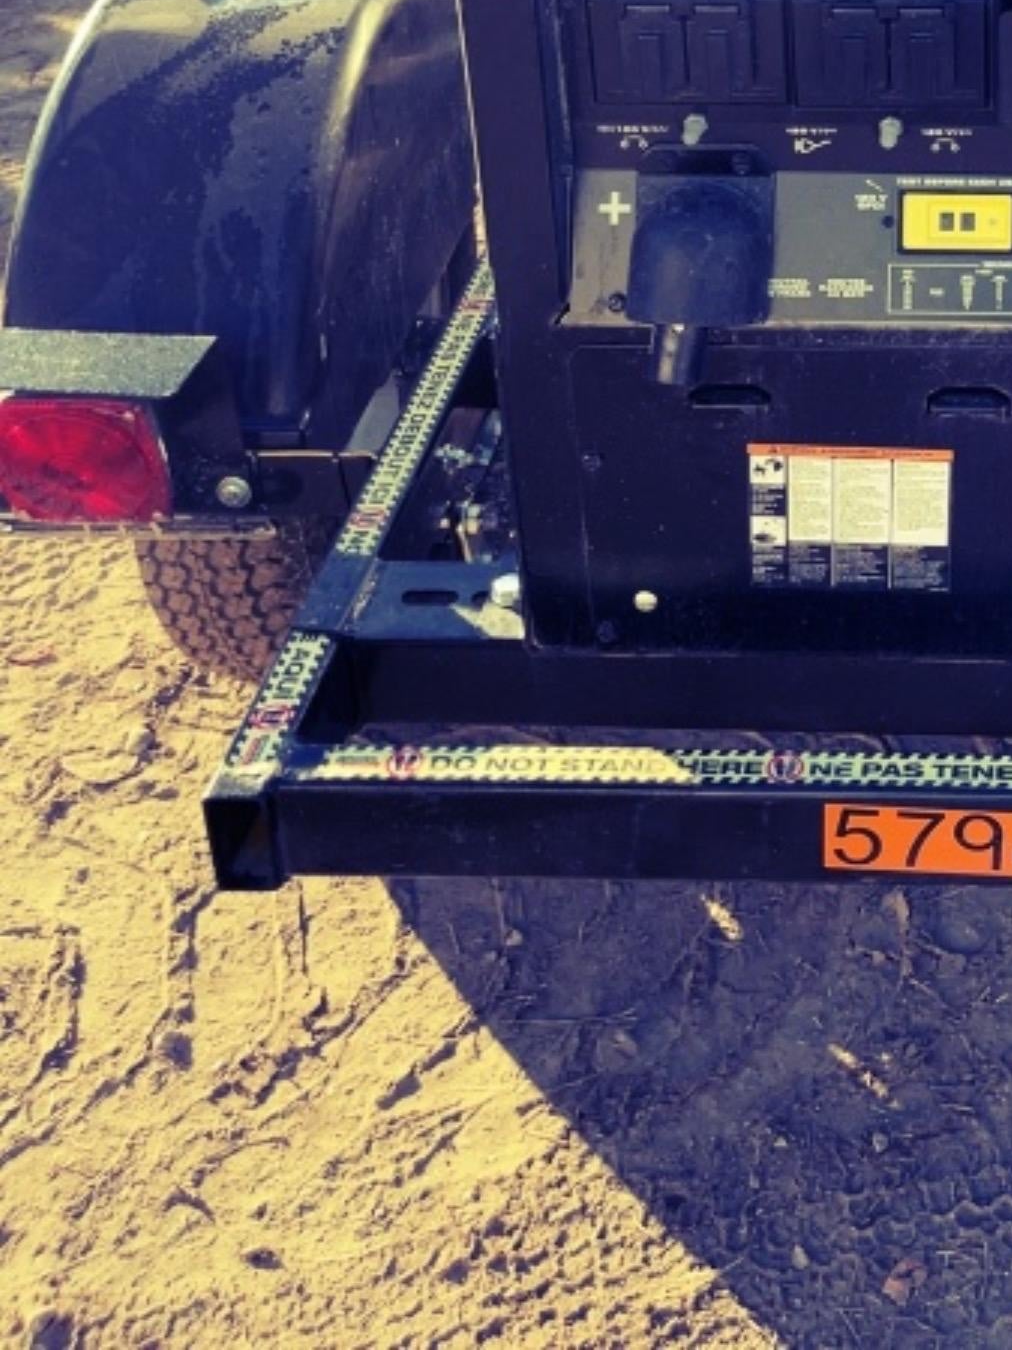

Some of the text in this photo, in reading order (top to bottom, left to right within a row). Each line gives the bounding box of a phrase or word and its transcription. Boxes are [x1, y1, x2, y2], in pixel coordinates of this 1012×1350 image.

[430, 755, 763, 777] DO NOT STAND HERE
[809, 761, 851, 777] NE
[861, 762, 924, 778] PAS
